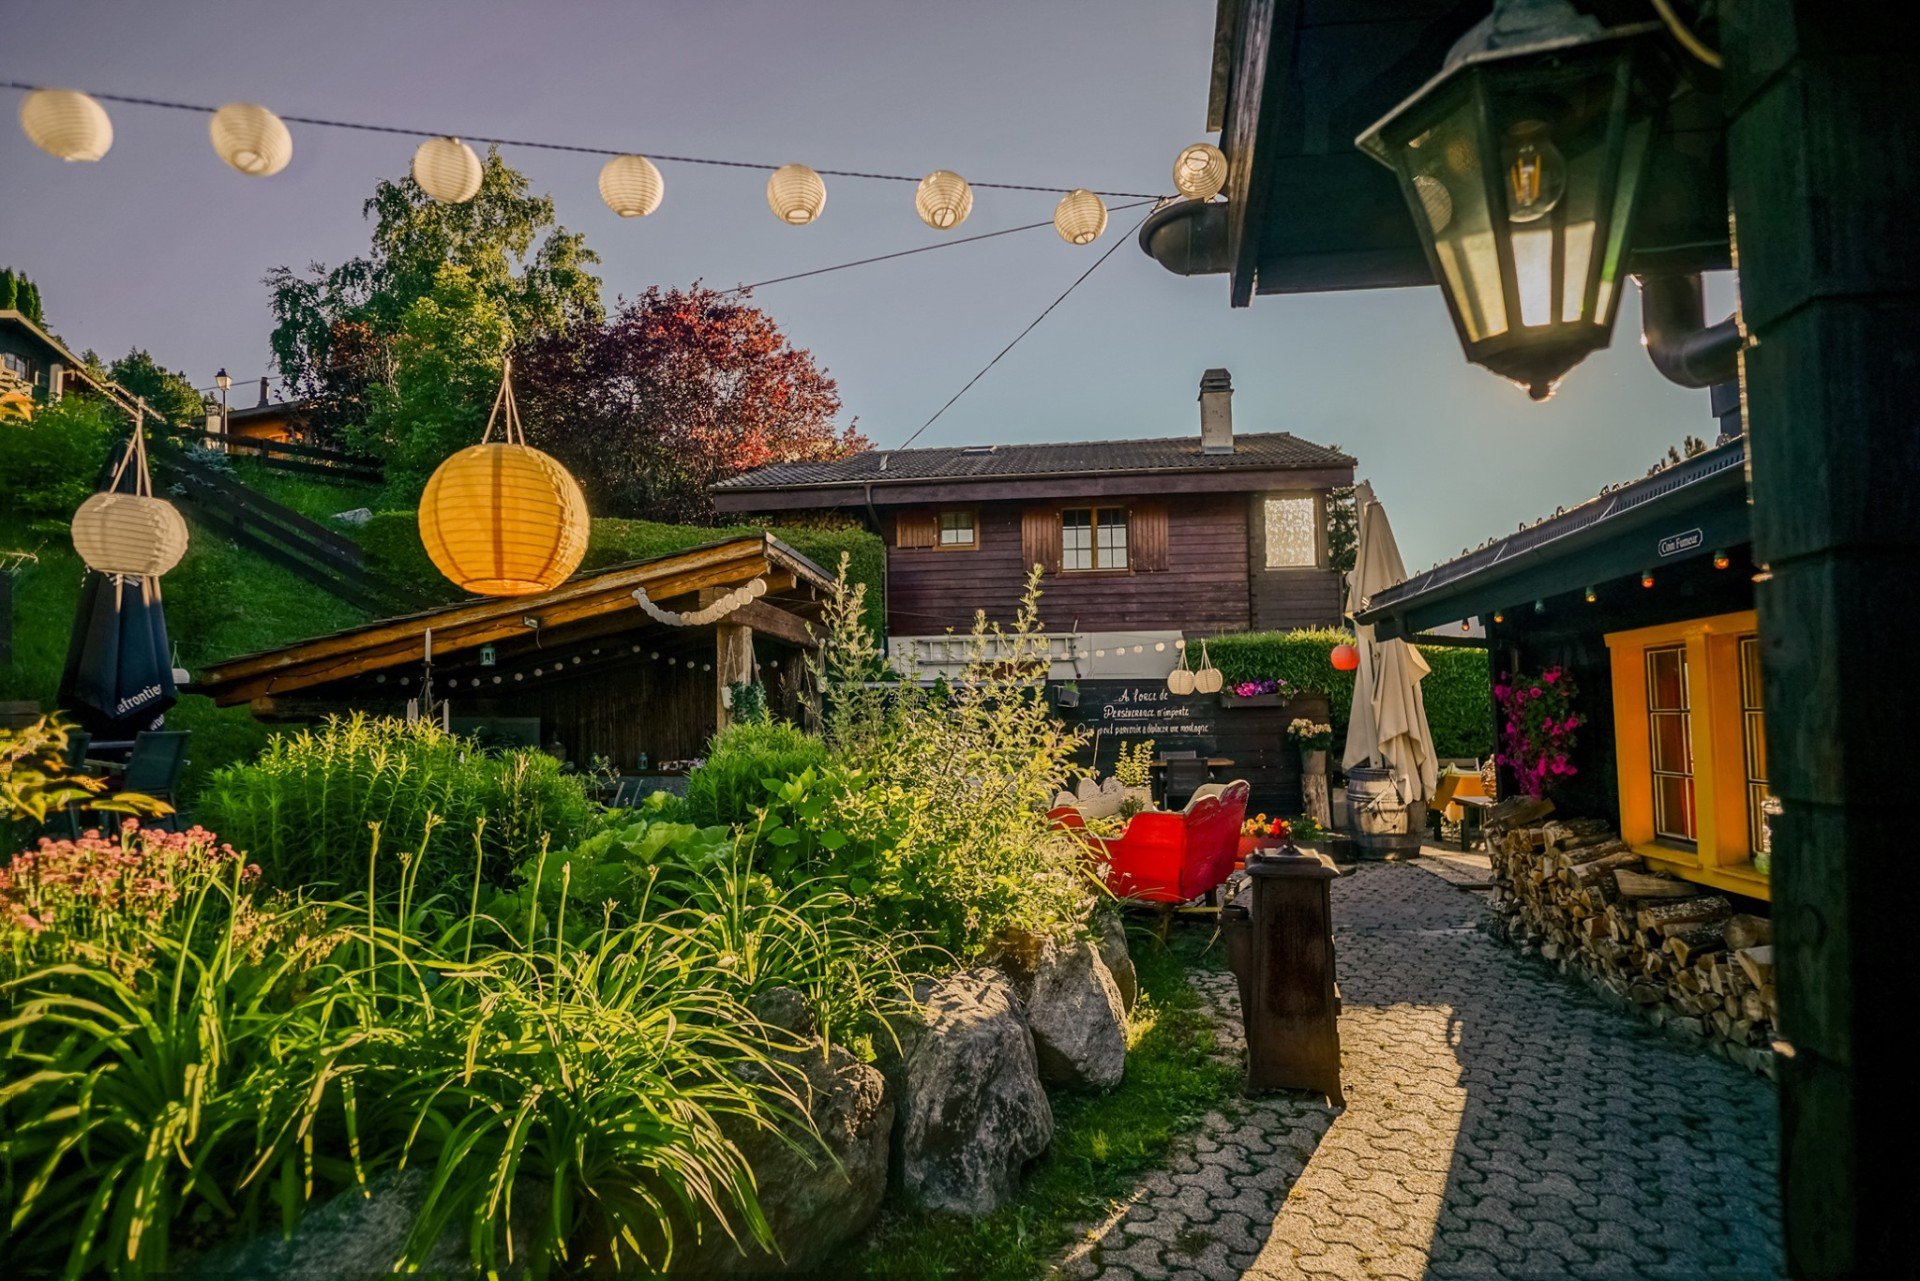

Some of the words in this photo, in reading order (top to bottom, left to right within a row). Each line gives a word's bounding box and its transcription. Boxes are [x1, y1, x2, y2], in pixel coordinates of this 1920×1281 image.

[1661, 540, 1675, 553] Coin
[1675, 535, 1698, 549] Fumeur
[1159, 688, 1168, 701] de
